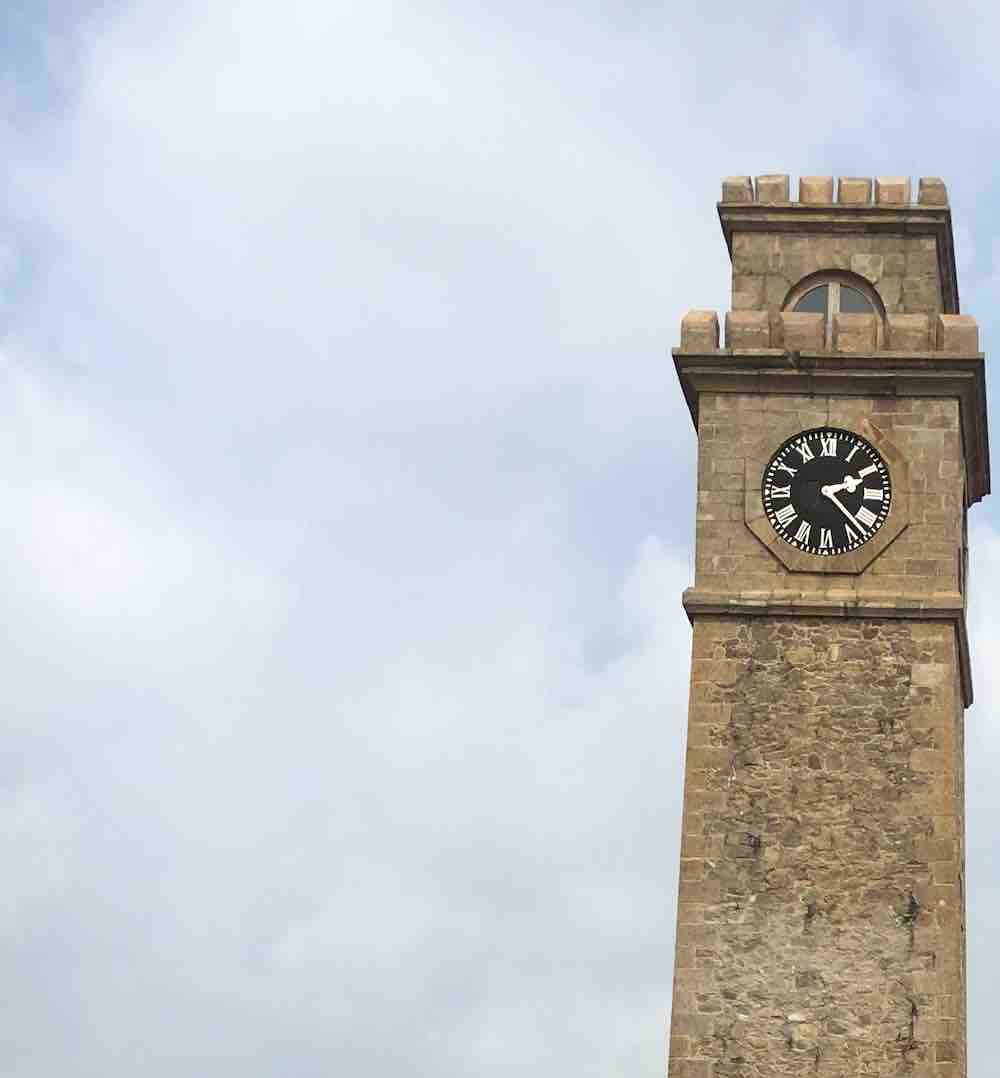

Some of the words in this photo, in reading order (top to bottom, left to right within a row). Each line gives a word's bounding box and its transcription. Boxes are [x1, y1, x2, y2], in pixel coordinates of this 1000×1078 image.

[796, 441, 815, 463] XI
[820, 438, 838, 456] XII
[845, 446, 860, 462] I
[777, 462, 798, 478] X
[858, 463, 878, 478] II
[771, 485, 791, 498] IX
[864, 488, 883, 500] III
[775, 504, 798, 528] VIII
[855, 506, 878, 528] IIII
[795, 520, 812, 545] VII
[819, 528, 833, 548] VI
[845, 524, 858, 543] V
